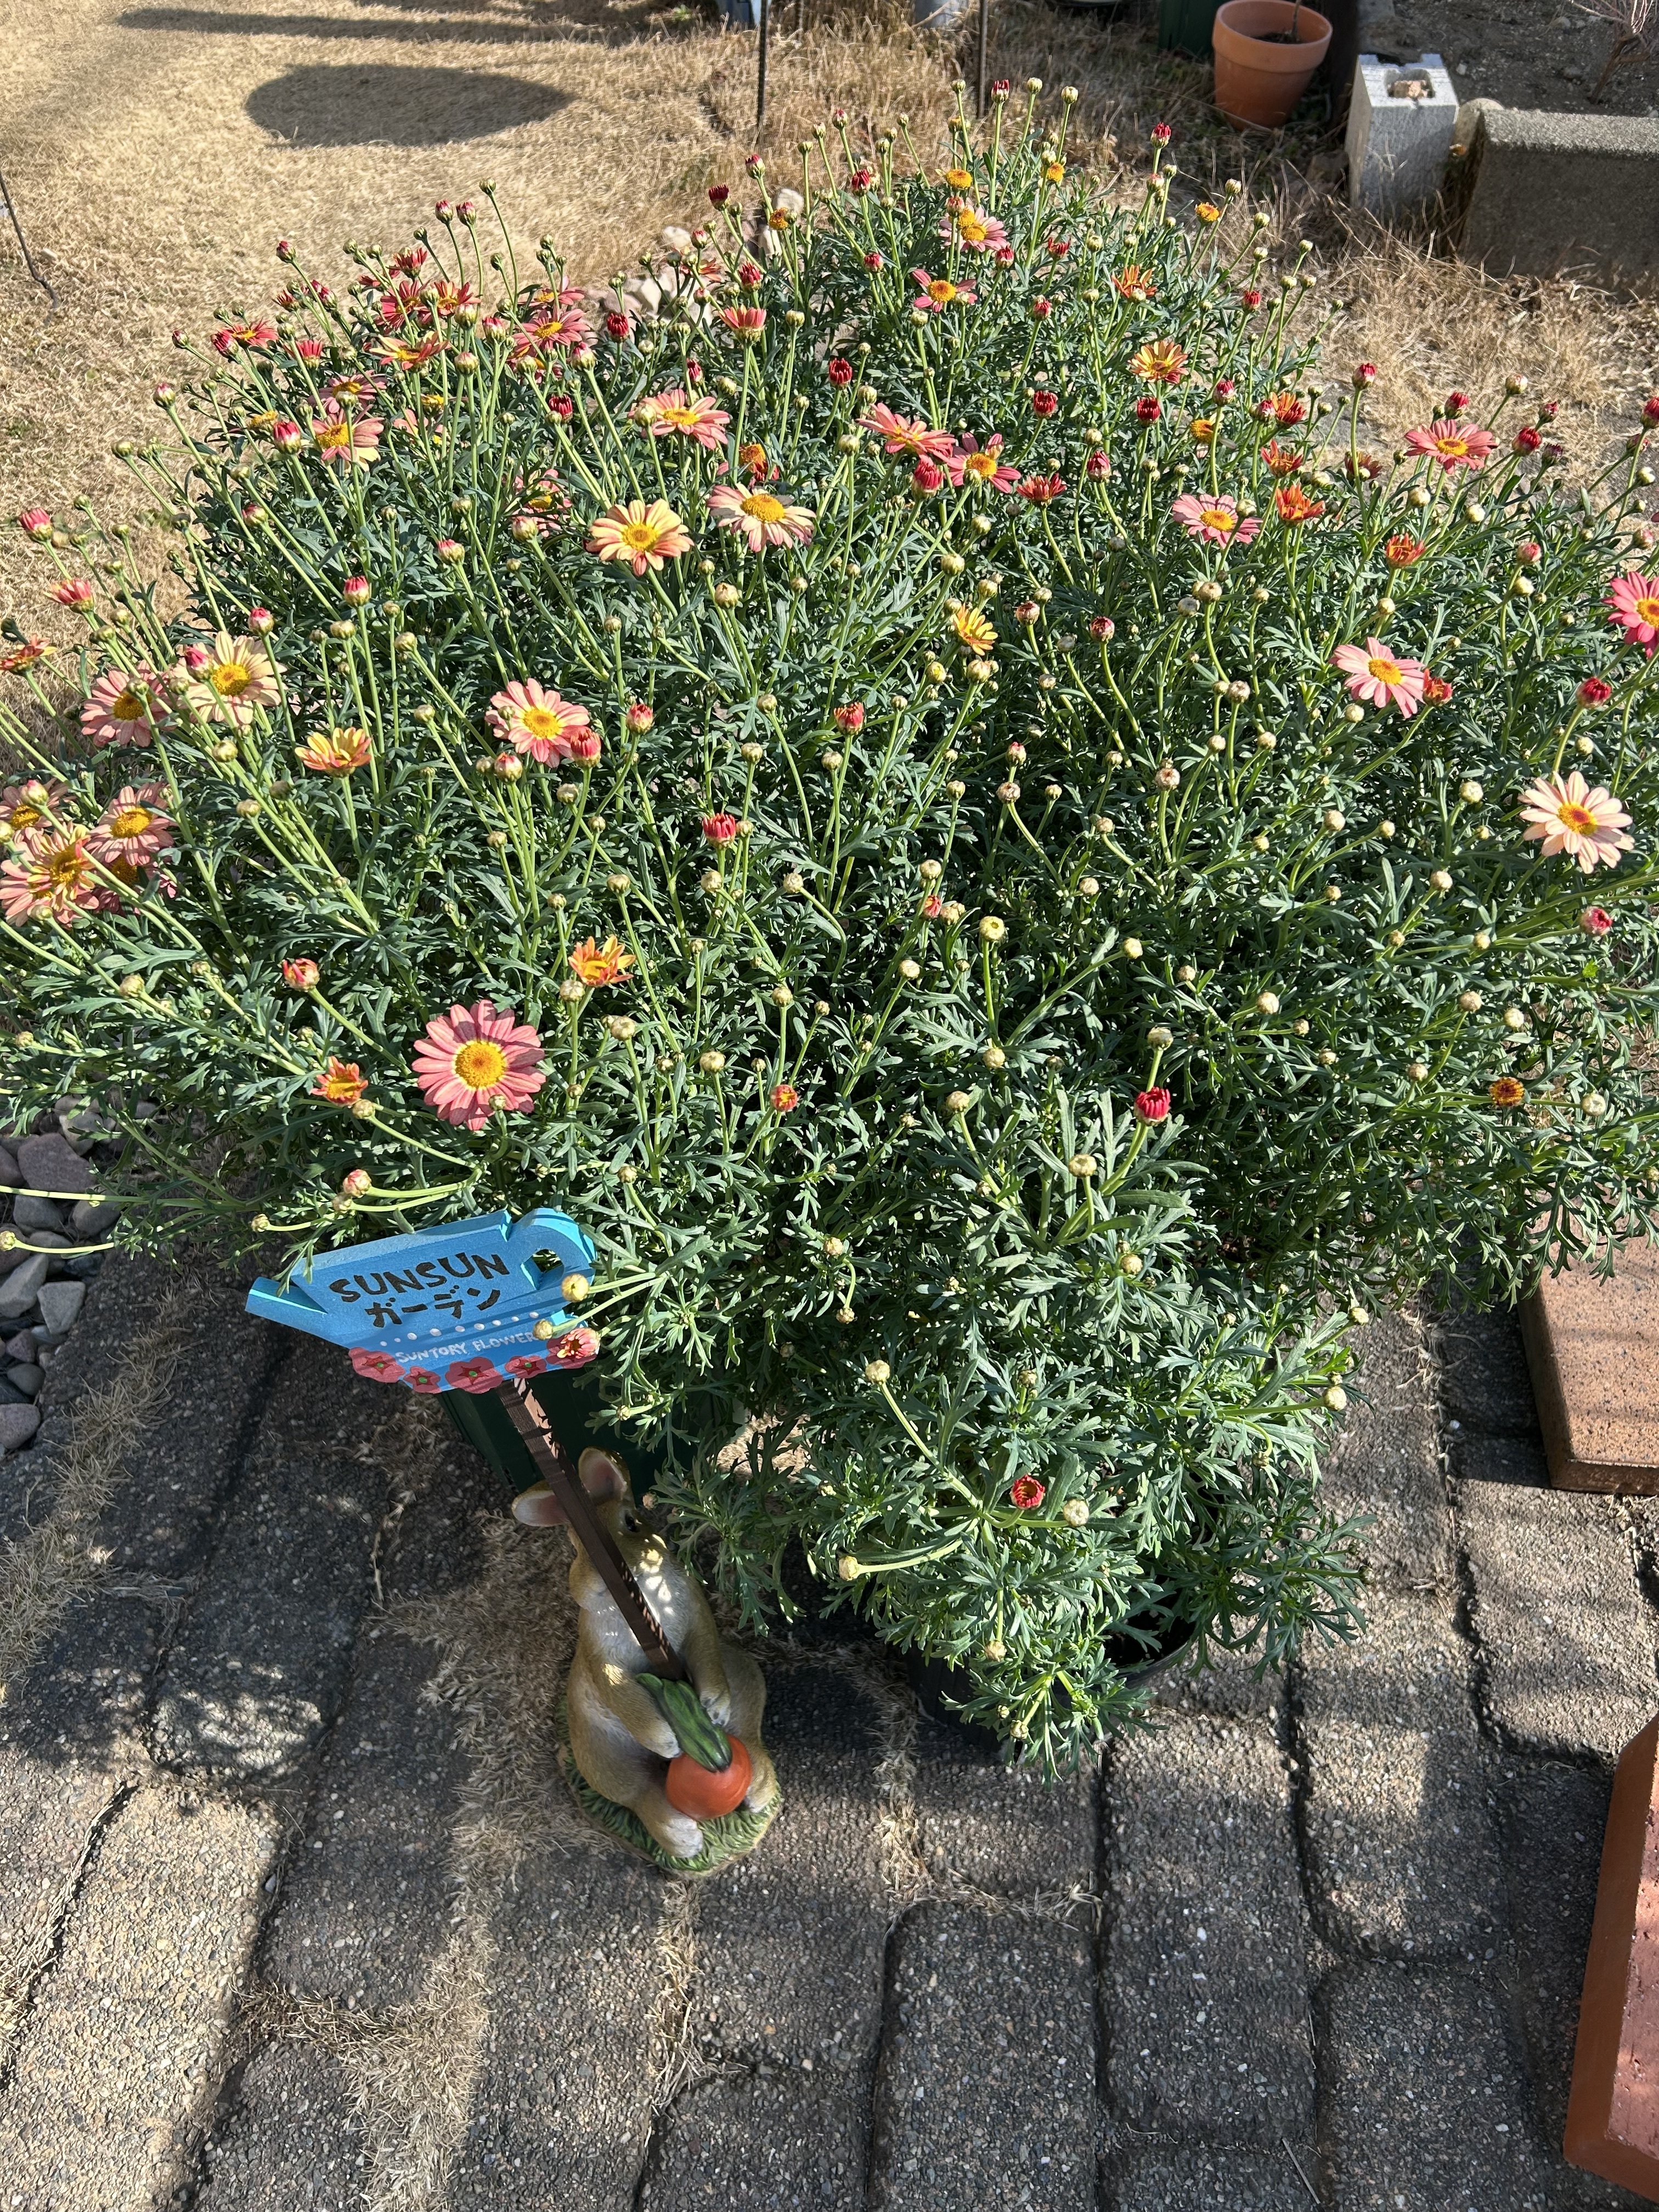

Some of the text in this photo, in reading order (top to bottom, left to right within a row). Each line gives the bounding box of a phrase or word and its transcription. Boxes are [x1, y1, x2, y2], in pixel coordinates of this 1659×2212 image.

[329, 1252, 510, 1302] SUNSUN
[365, 1285, 500, 1328] ガーデン
[395, 1342, 467, 1363] SUNTORY
